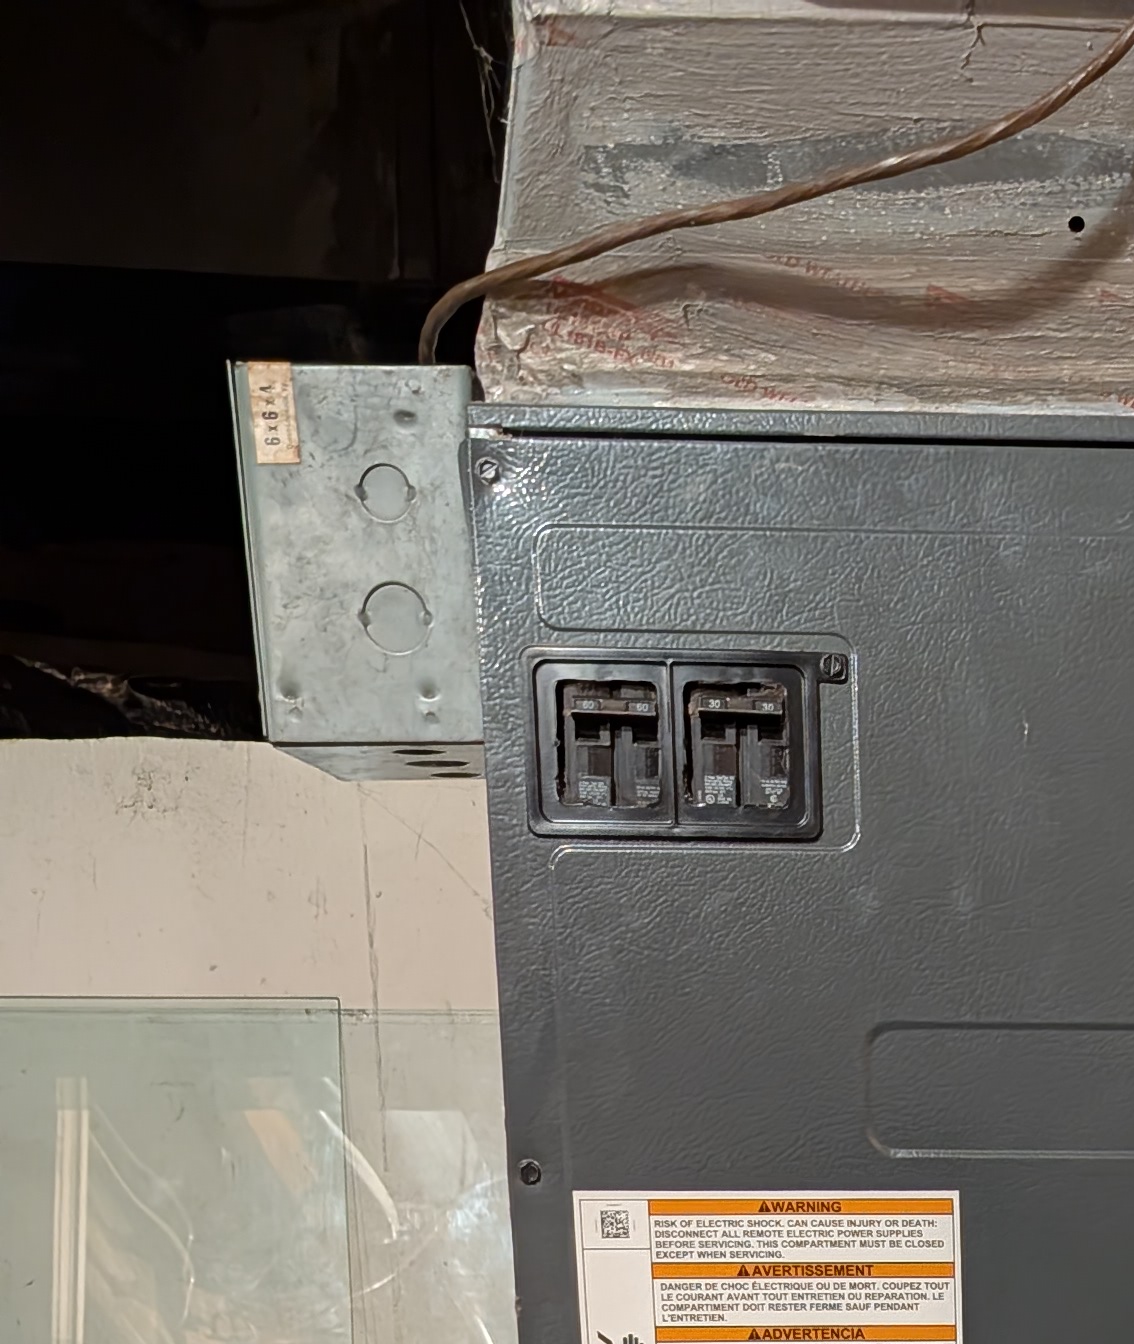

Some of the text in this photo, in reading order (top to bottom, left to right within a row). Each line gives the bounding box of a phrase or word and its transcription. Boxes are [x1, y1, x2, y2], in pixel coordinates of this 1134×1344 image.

[262, 410, 278, 420] 6
[264, 436, 280, 446] 6
[636, 702, 649, 712] 60
[708, 699, 774, 712] 30 30
[771, 1200, 842, 1213] WARNING
[653, 1218, 938, 1228] RISK OF ELECTRIC SHOCK. CAN CAUSE INJURY OR DEATH:
[654, 1229, 924, 1238] DISCONNECT ALL REMOTE ELECTRIC POWER SUPPLIES
[654, 1239, 945, 1249] BEFORE SERVICING. THIS COMPARTMENT MUST BE CLOSED
[655, 1250, 785, 1259] EXCEPT WHEN SERVICING.
[752, 1264, 874, 1278] AVERTISSEMENT
[660, 1281, 950, 1291] DANGER DE CHOC ÉLECTRIQUE OU DE MORT. COUPEZ TOUT
[660, 1291, 945, 1301] LE COURANT AVANT TOUT ENTRETIEN OU REPARATION. LE
[661, 1302, 920, 1311] COMPARTIMENT DOIT RESTER FERME SAUF PENDANT
[762, 1328, 866, 1341] ADVERTENCIA
